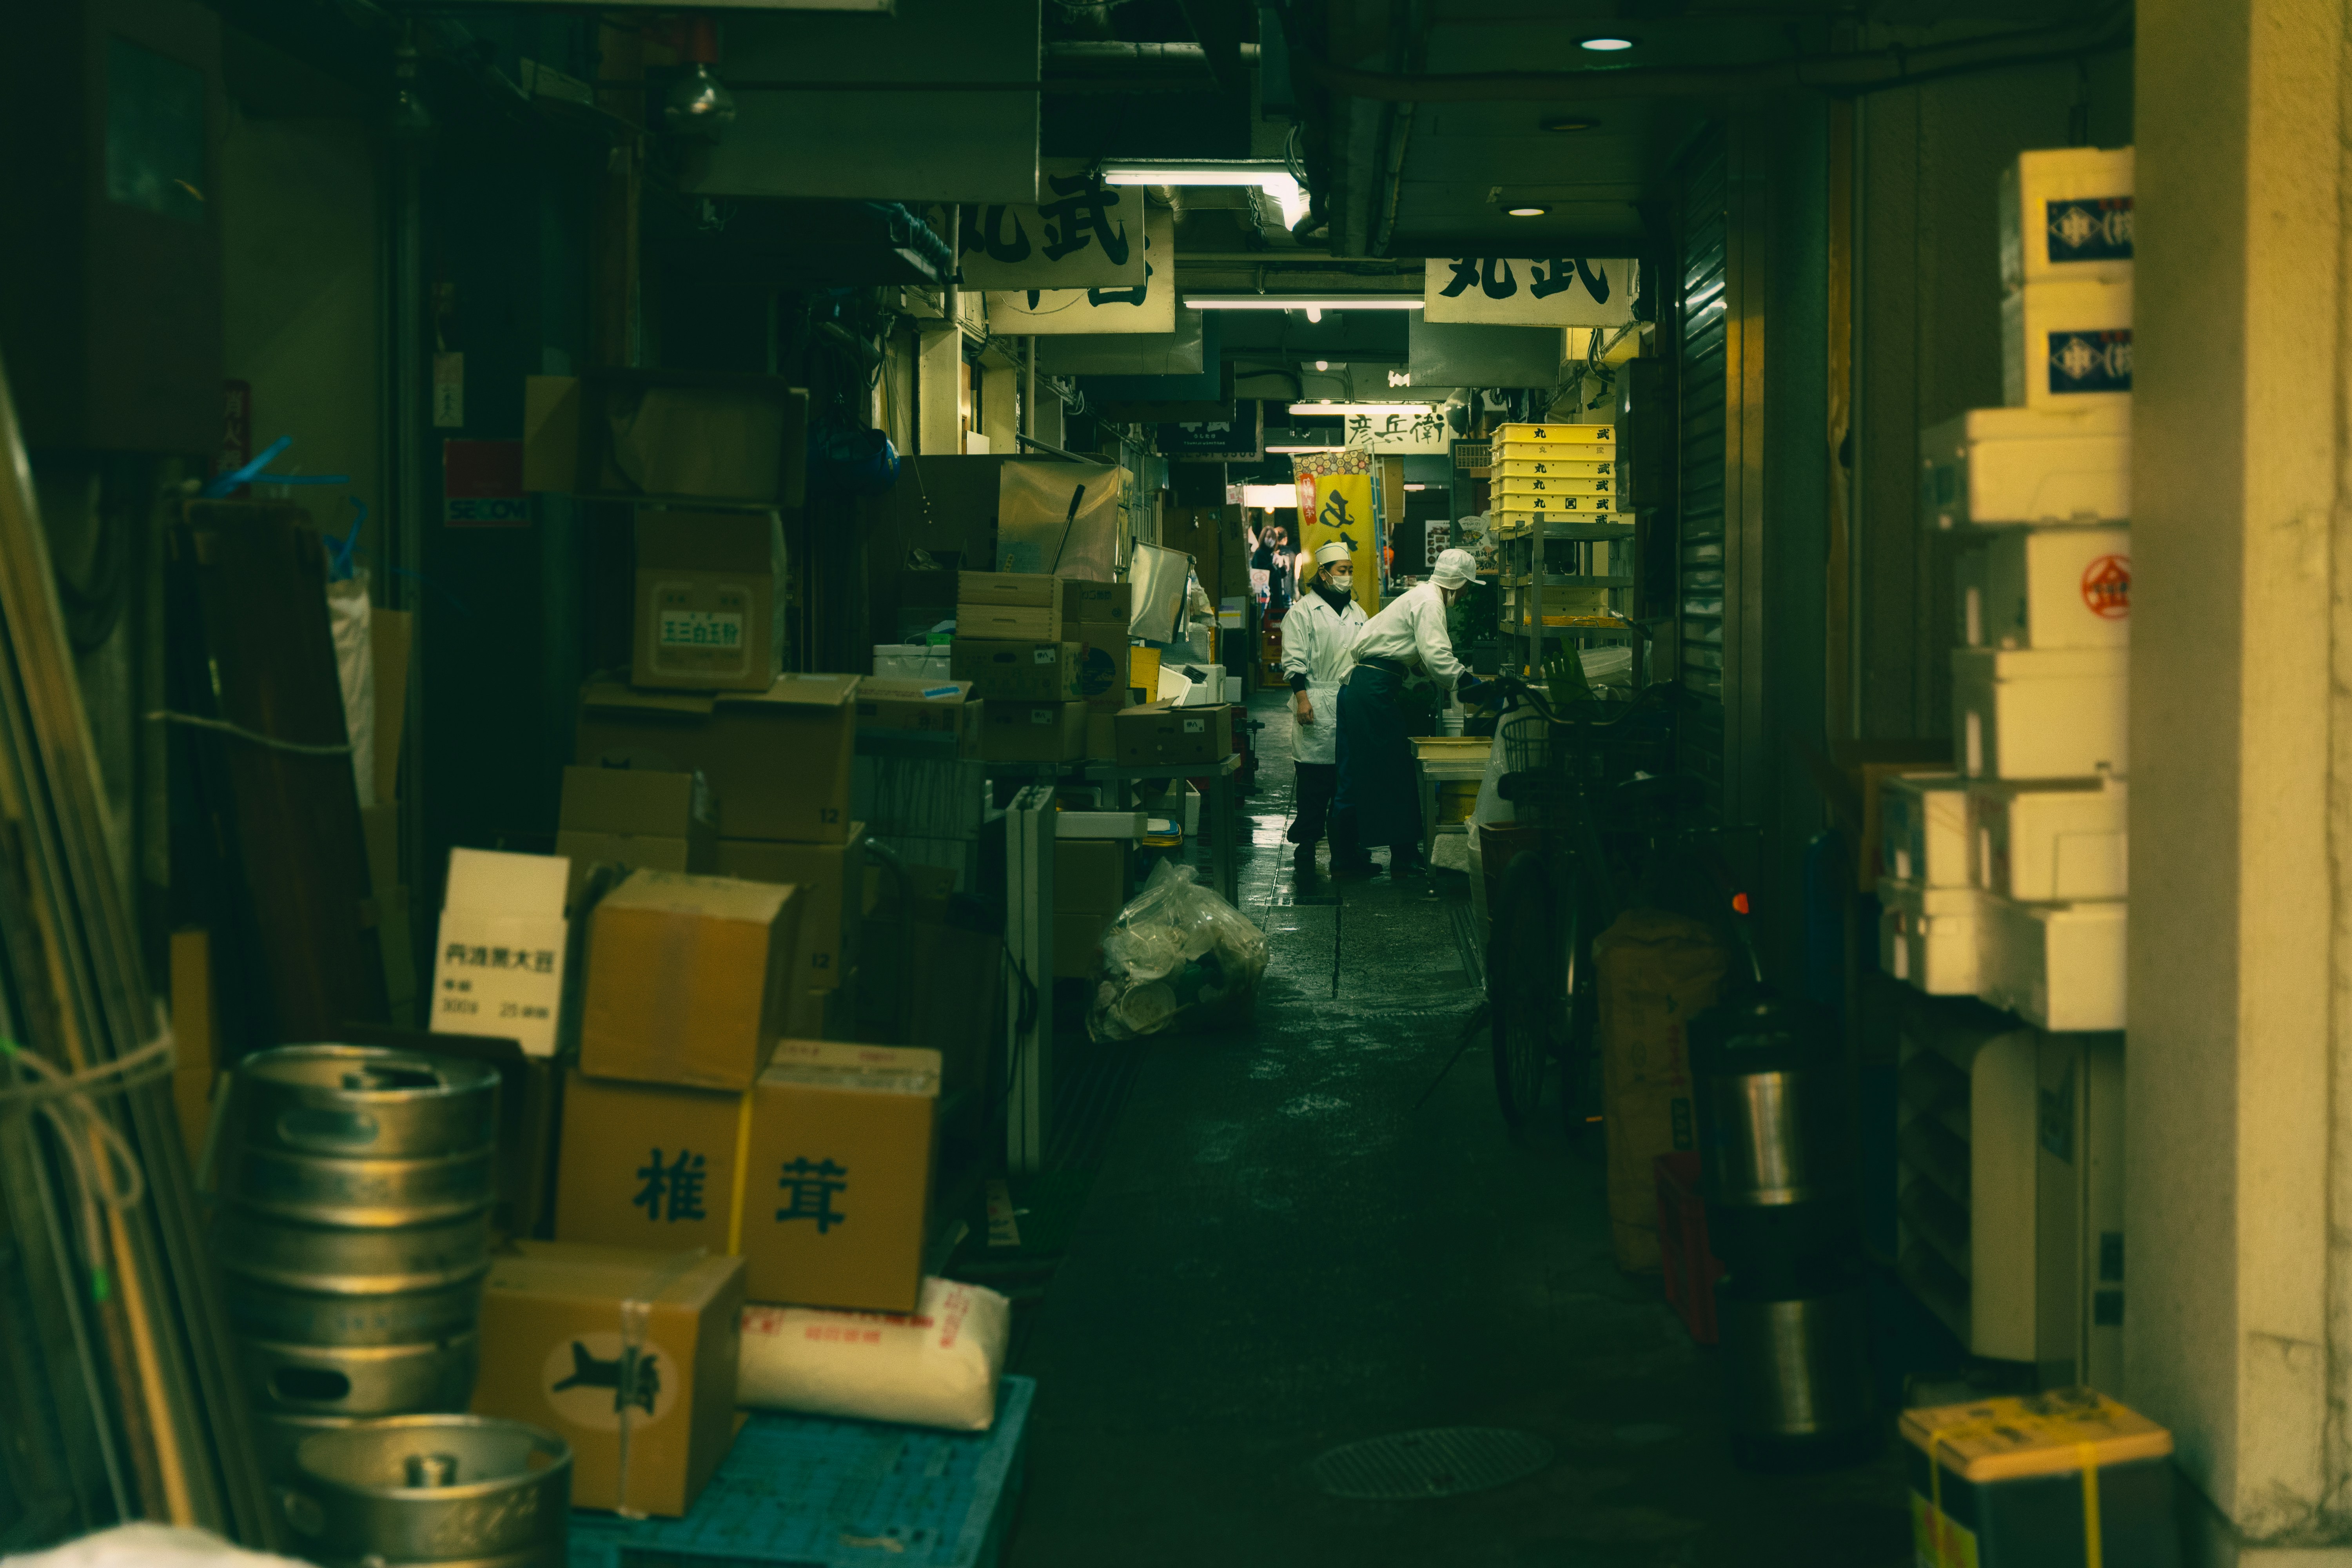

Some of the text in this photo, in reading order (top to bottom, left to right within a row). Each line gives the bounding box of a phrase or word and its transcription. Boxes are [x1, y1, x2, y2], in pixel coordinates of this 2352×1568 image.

[1534, 428, 1610, 439] 丸 武
[1534, 463, 1610, 475] 丸 武
[1533, 480, 1609, 492] 丸 武
[449, 499, 527, 520] SECOM
[1533, 498, 1546, 508] 丸
[1596, 499, 1609, 510] 武
[820, 808, 839, 824] 12
[812, 953, 830, 969] 12
[633, 1147, 847, 1234] 椎 茸
